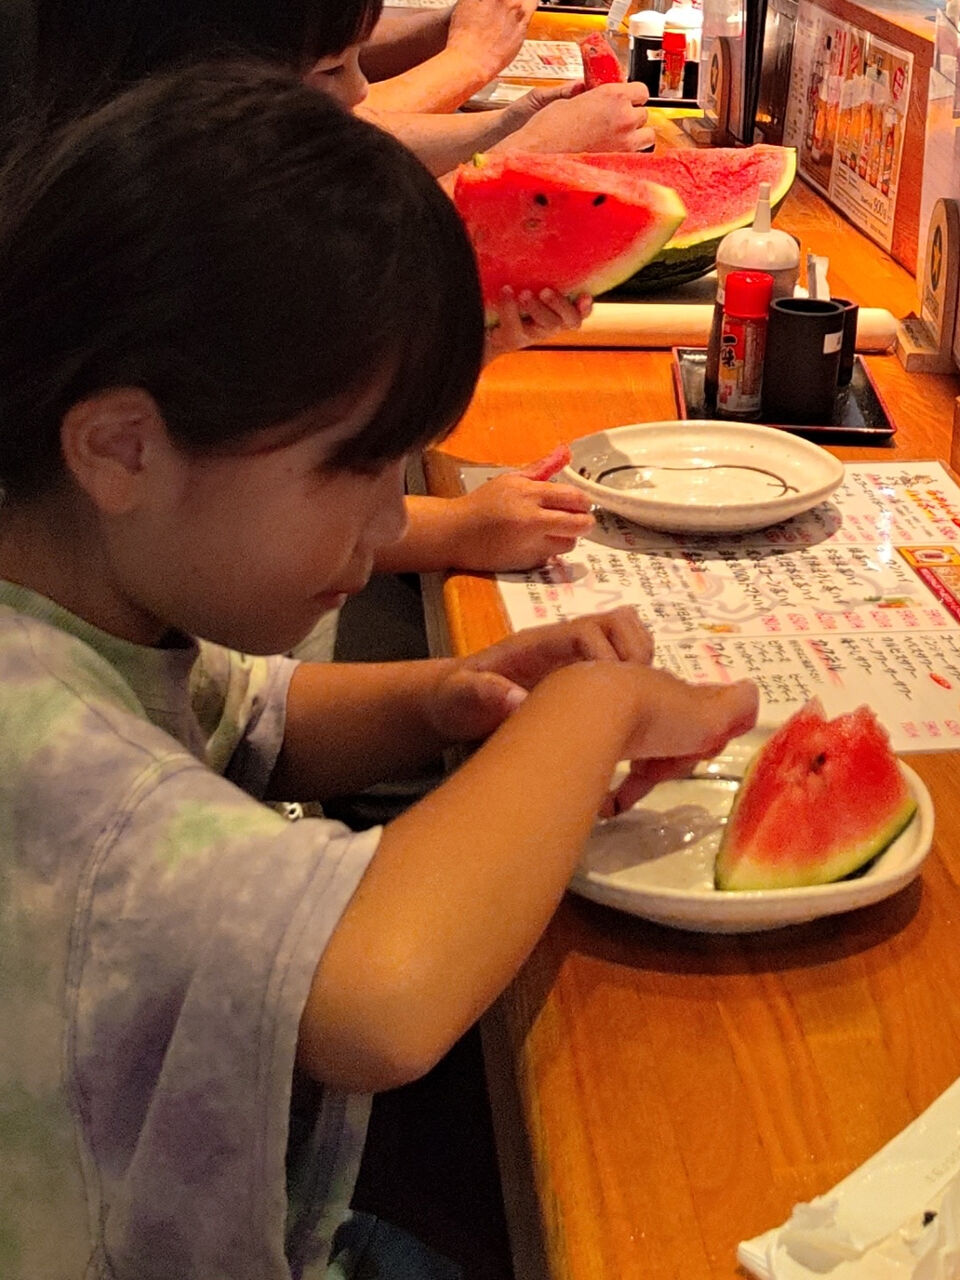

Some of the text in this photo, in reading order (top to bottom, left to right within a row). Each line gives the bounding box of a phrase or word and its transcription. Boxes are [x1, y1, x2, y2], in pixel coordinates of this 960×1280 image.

[705, 642, 737, 668] ワイン
[807, 638, 847, 670] カクテル
